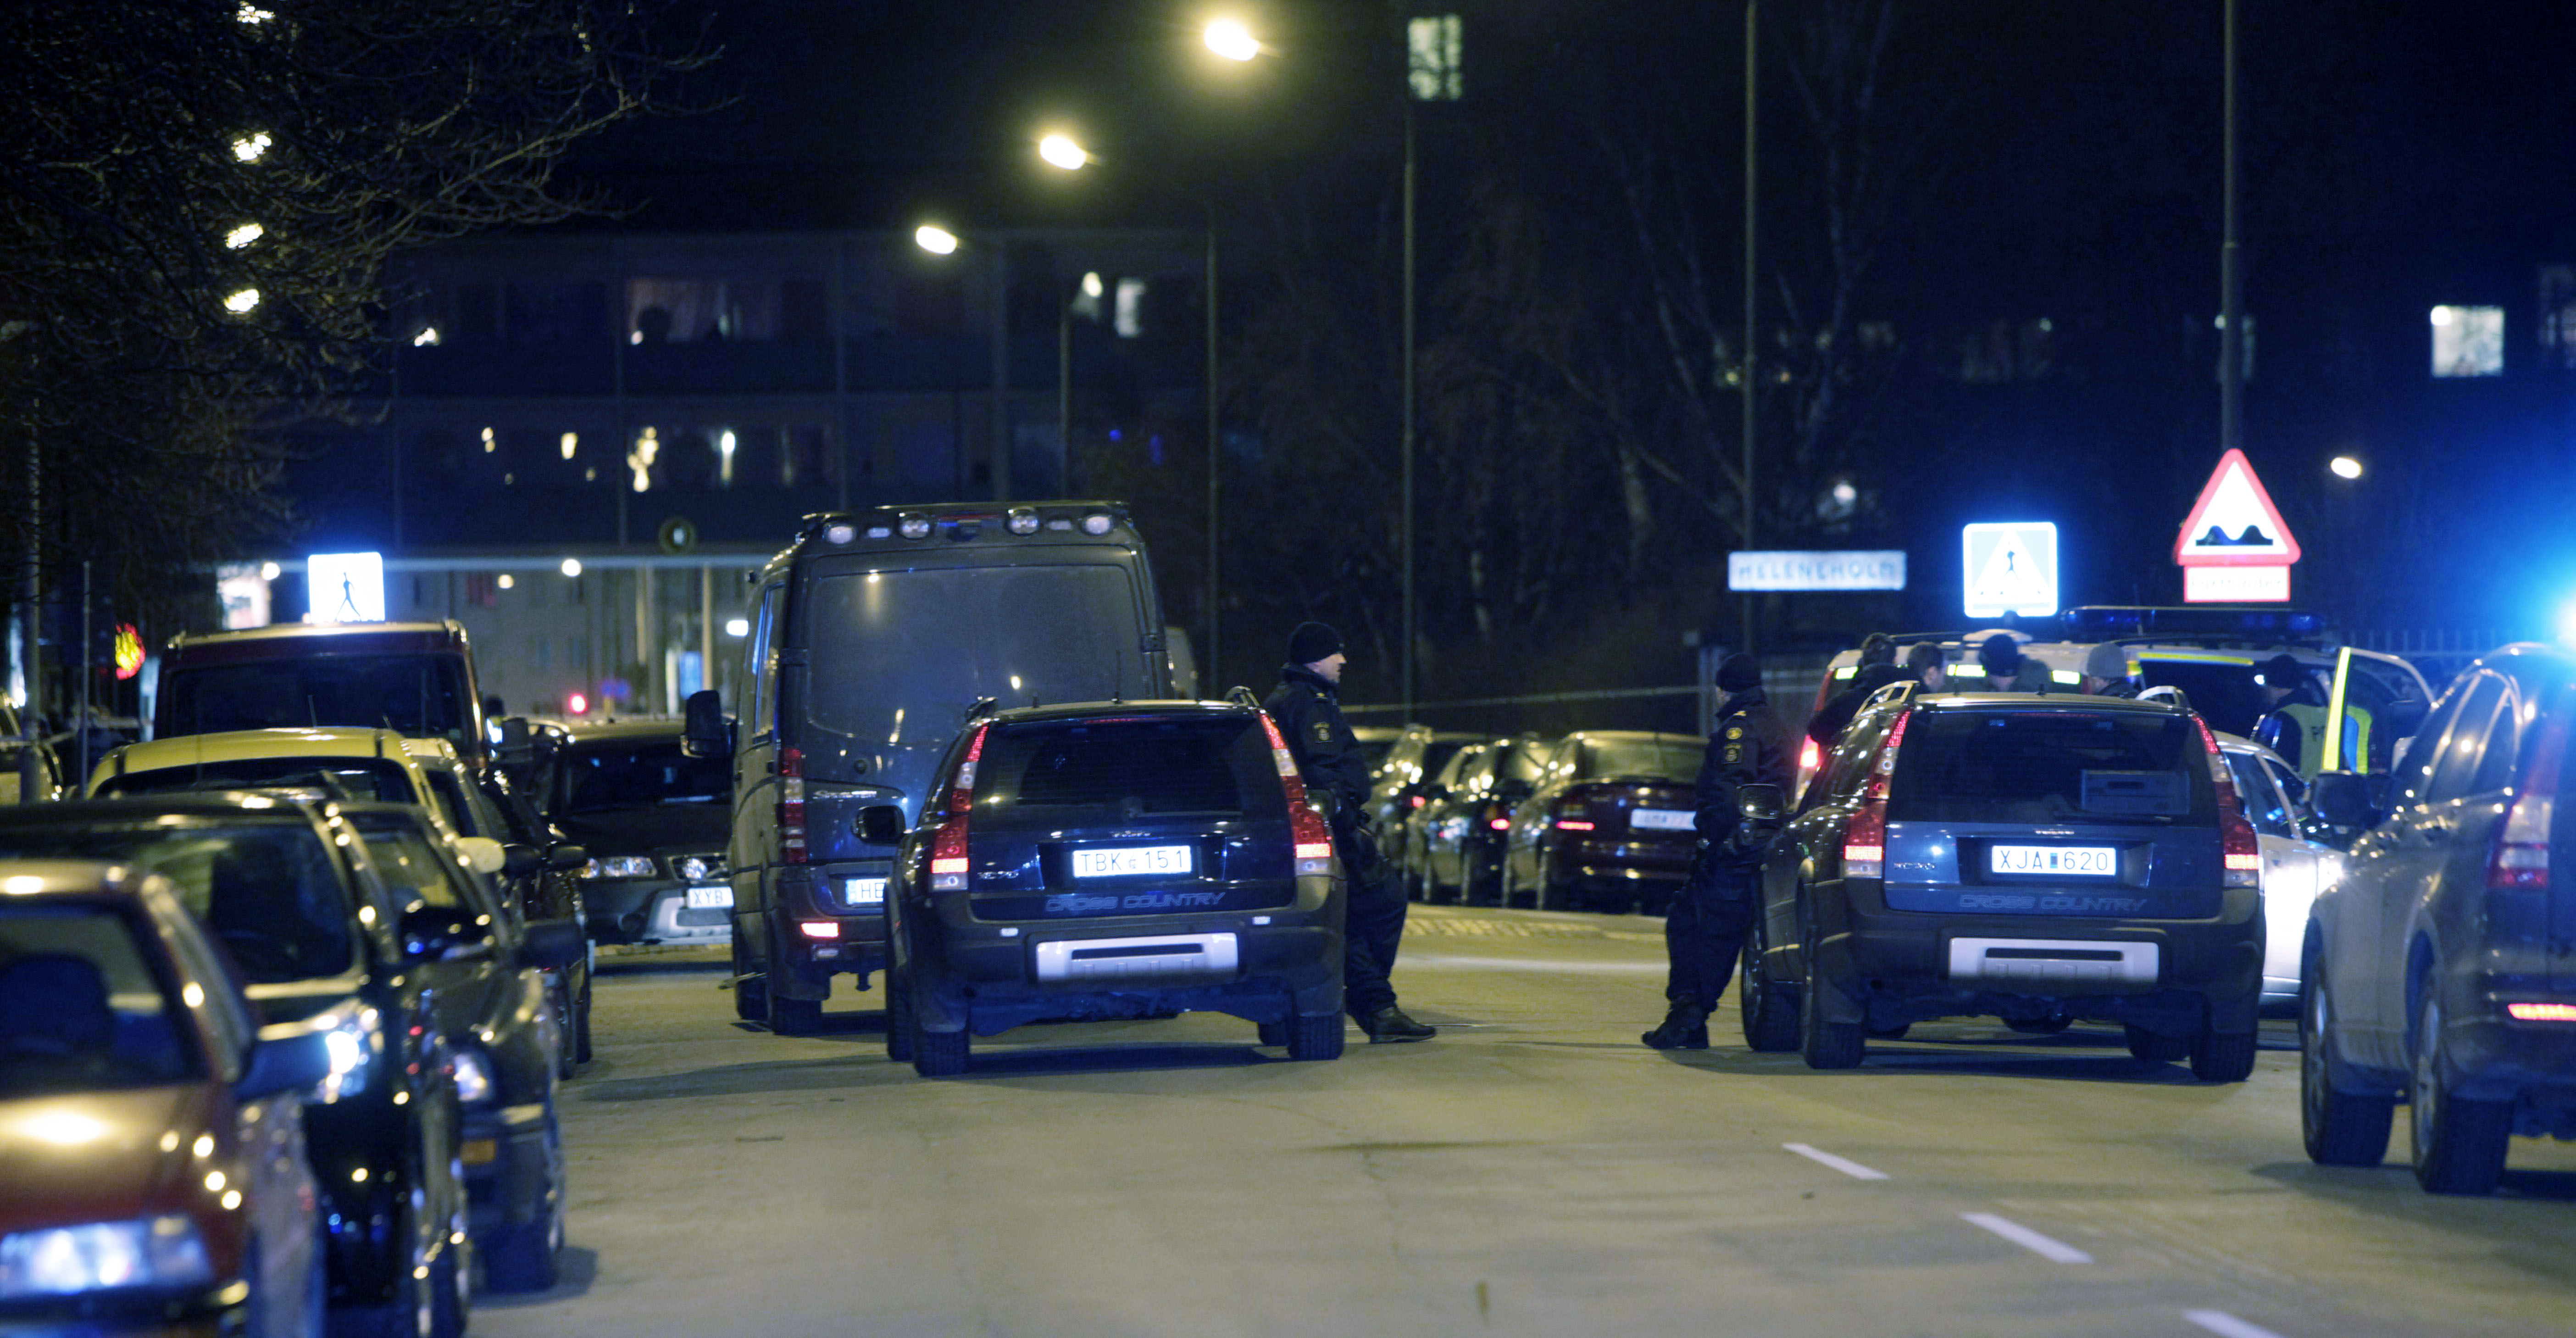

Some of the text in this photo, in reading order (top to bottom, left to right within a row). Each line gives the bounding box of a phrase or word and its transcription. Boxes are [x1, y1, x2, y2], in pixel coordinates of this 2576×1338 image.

[1738, 561, 1895, 580] HELENEHOLM
[1080, 850, 1183, 872] TBK 151
[2000, 850, 2108, 871] XJA 620
[694, 890, 723, 904] XYB
[1045, 892, 1226, 912] CROSS COUNTRY
[1959, 894, 2148, 911] CROSS COUNTRY
